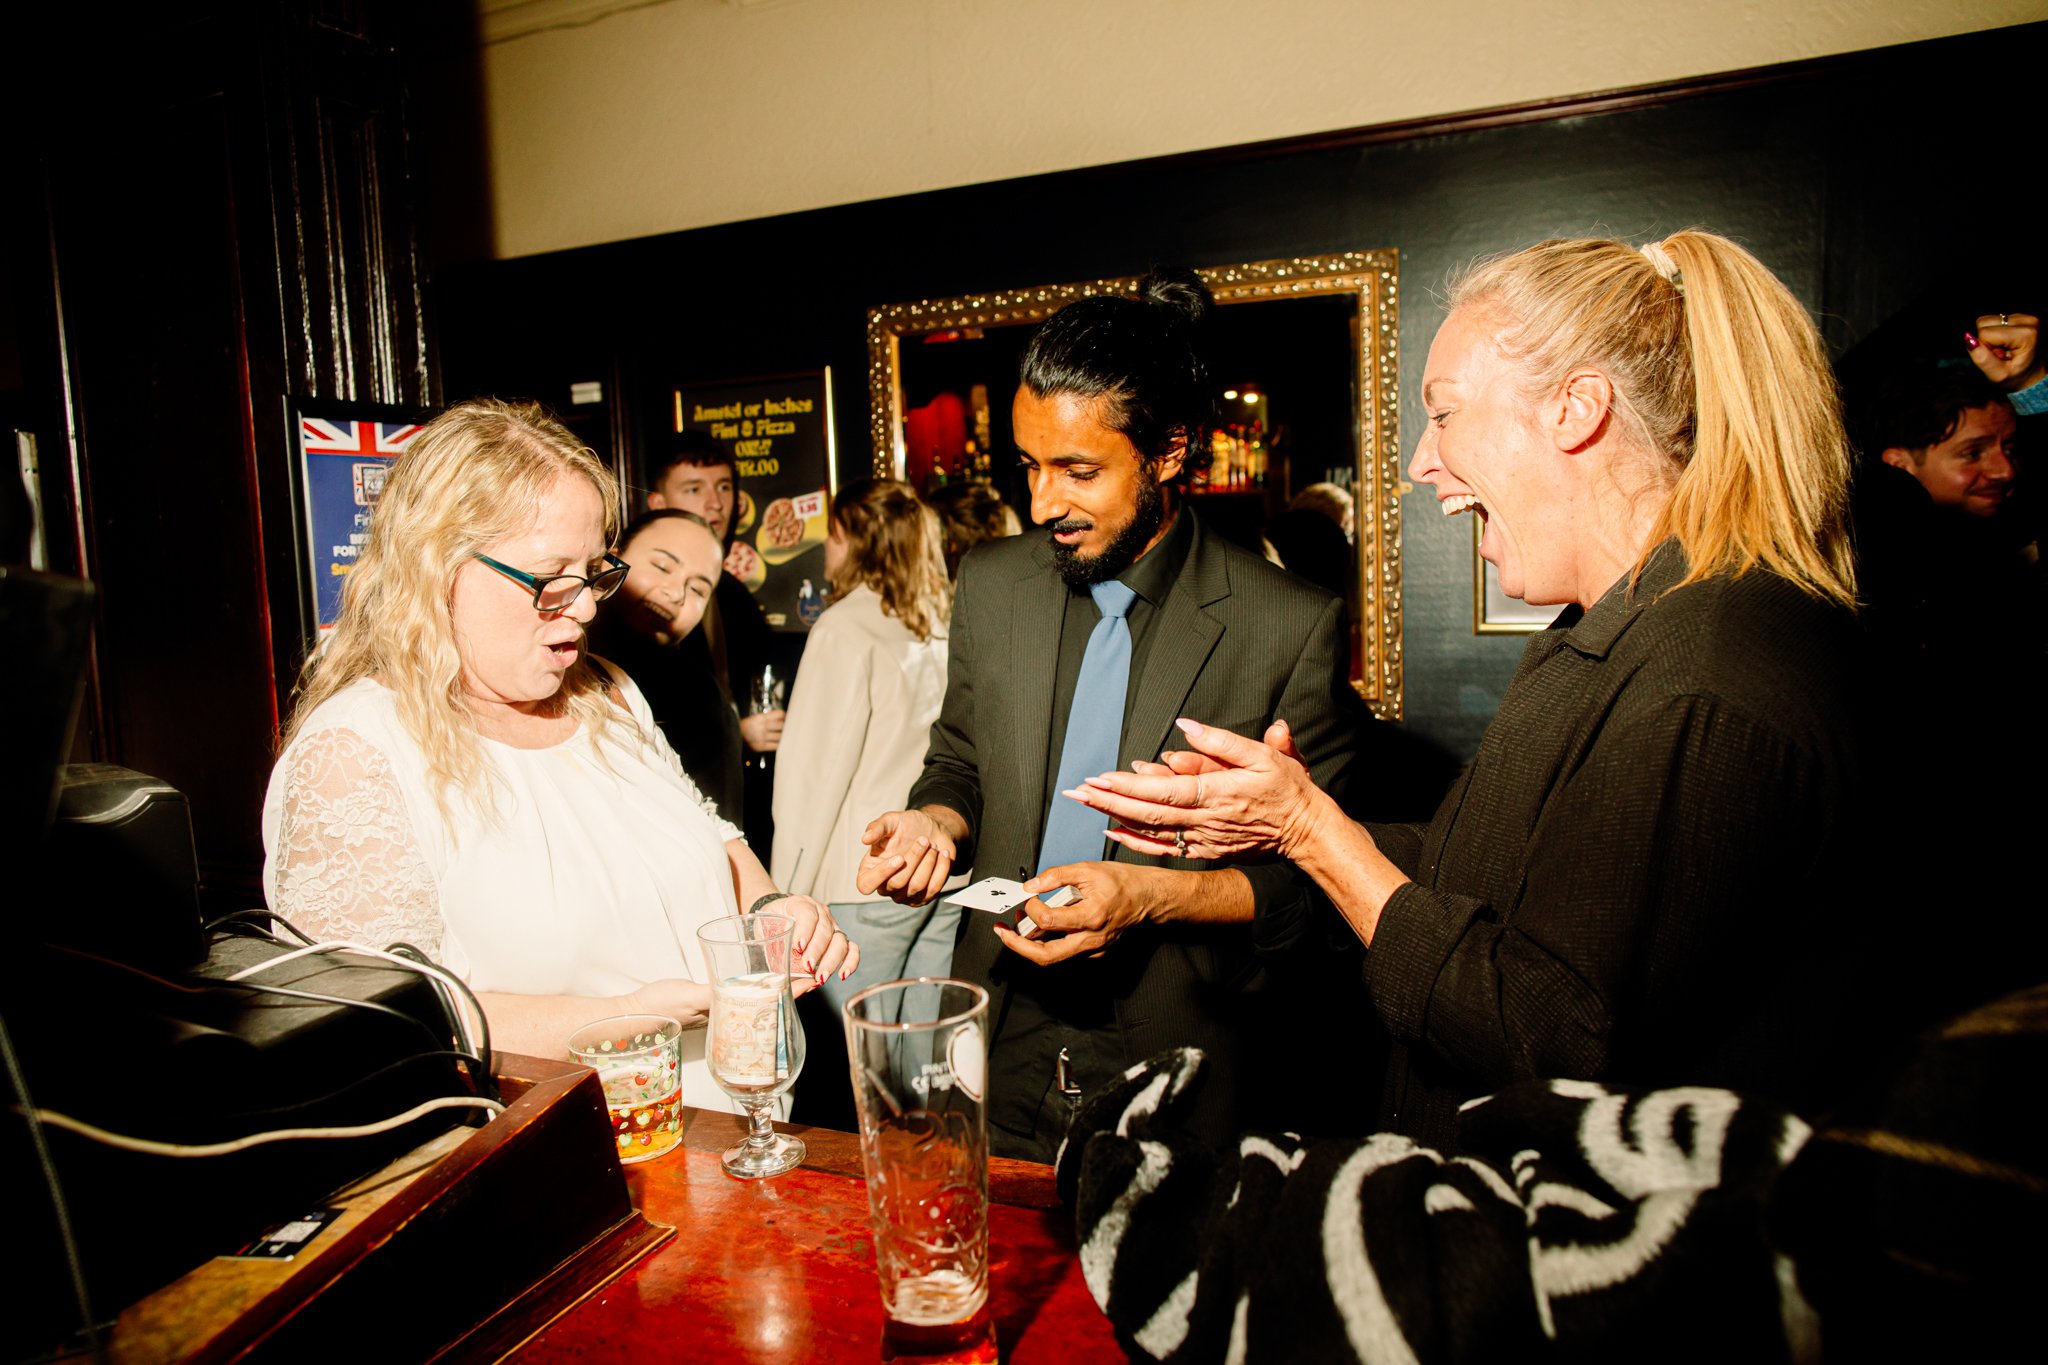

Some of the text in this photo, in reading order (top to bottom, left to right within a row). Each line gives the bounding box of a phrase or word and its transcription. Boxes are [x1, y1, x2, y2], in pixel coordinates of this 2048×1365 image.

[694, 397, 813, 422] Amstel or Inches
[711, 419, 796, 440] Pint & Pizza
[333, 545, 357, 558] FOR
